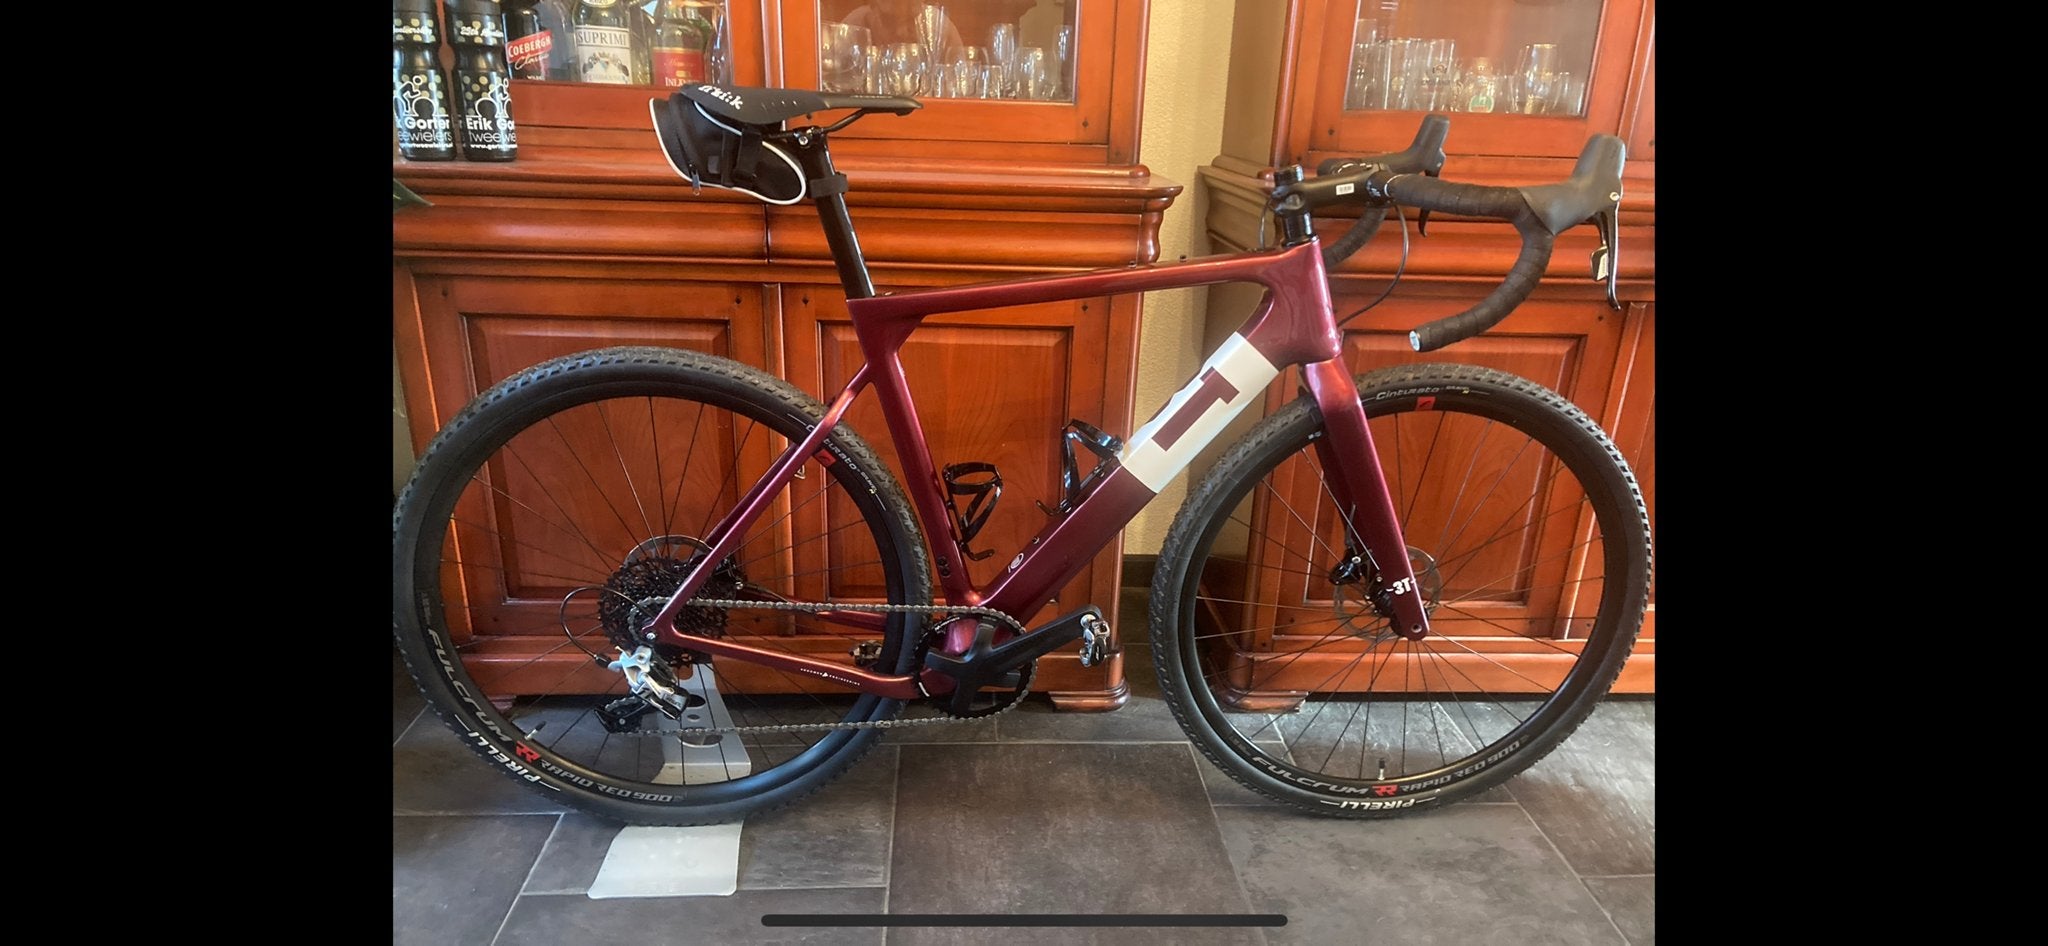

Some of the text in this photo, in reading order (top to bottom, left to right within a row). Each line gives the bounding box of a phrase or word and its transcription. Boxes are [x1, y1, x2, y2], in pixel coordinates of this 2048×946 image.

[405, 117, 450, 130] Gorter
[466, 117, 494, 131] Erik
[428, 628, 513, 742] FULCRUM
[539, 759, 593, 788] RAPID
[596, 783, 632, 798] RED
[633, 794, 674, 803] 900
[468, 731, 541, 783] PIRELLI
[1252, 756, 1369, 795] FULCRUM
[1400, 775, 1452, 792] RAPID
[1454, 761, 1486, 778] RED
[1487, 741, 1520, 765] 900
[1340, 799, 1415, 811] PIRELLI
